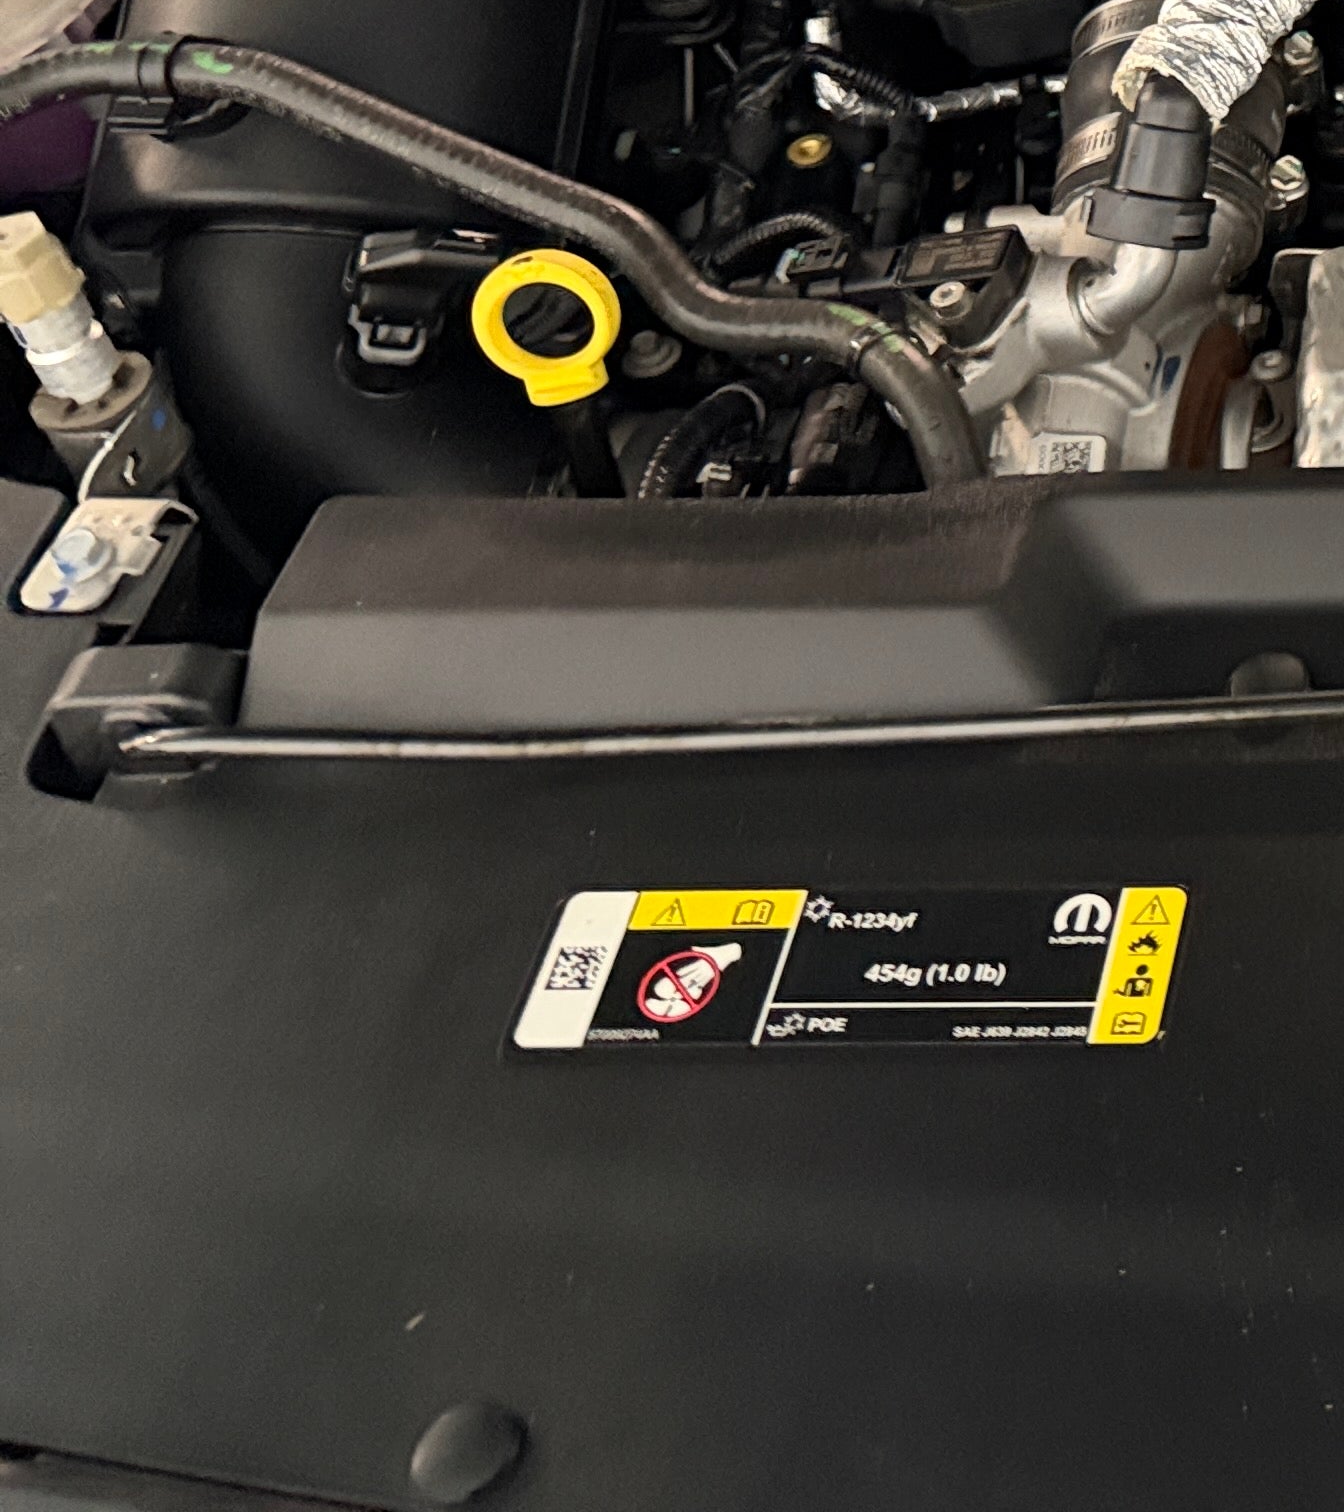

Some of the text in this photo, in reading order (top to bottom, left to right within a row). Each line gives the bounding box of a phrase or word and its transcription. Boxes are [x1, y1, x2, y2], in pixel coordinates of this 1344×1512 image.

[828, 912, 918, 933] R-1234yf
[864, 963, 1007, 987] 454g (1.0 lb)
[807, 1017, 848, 1033] POE
[952, 1026, 981, 1038] SAE
